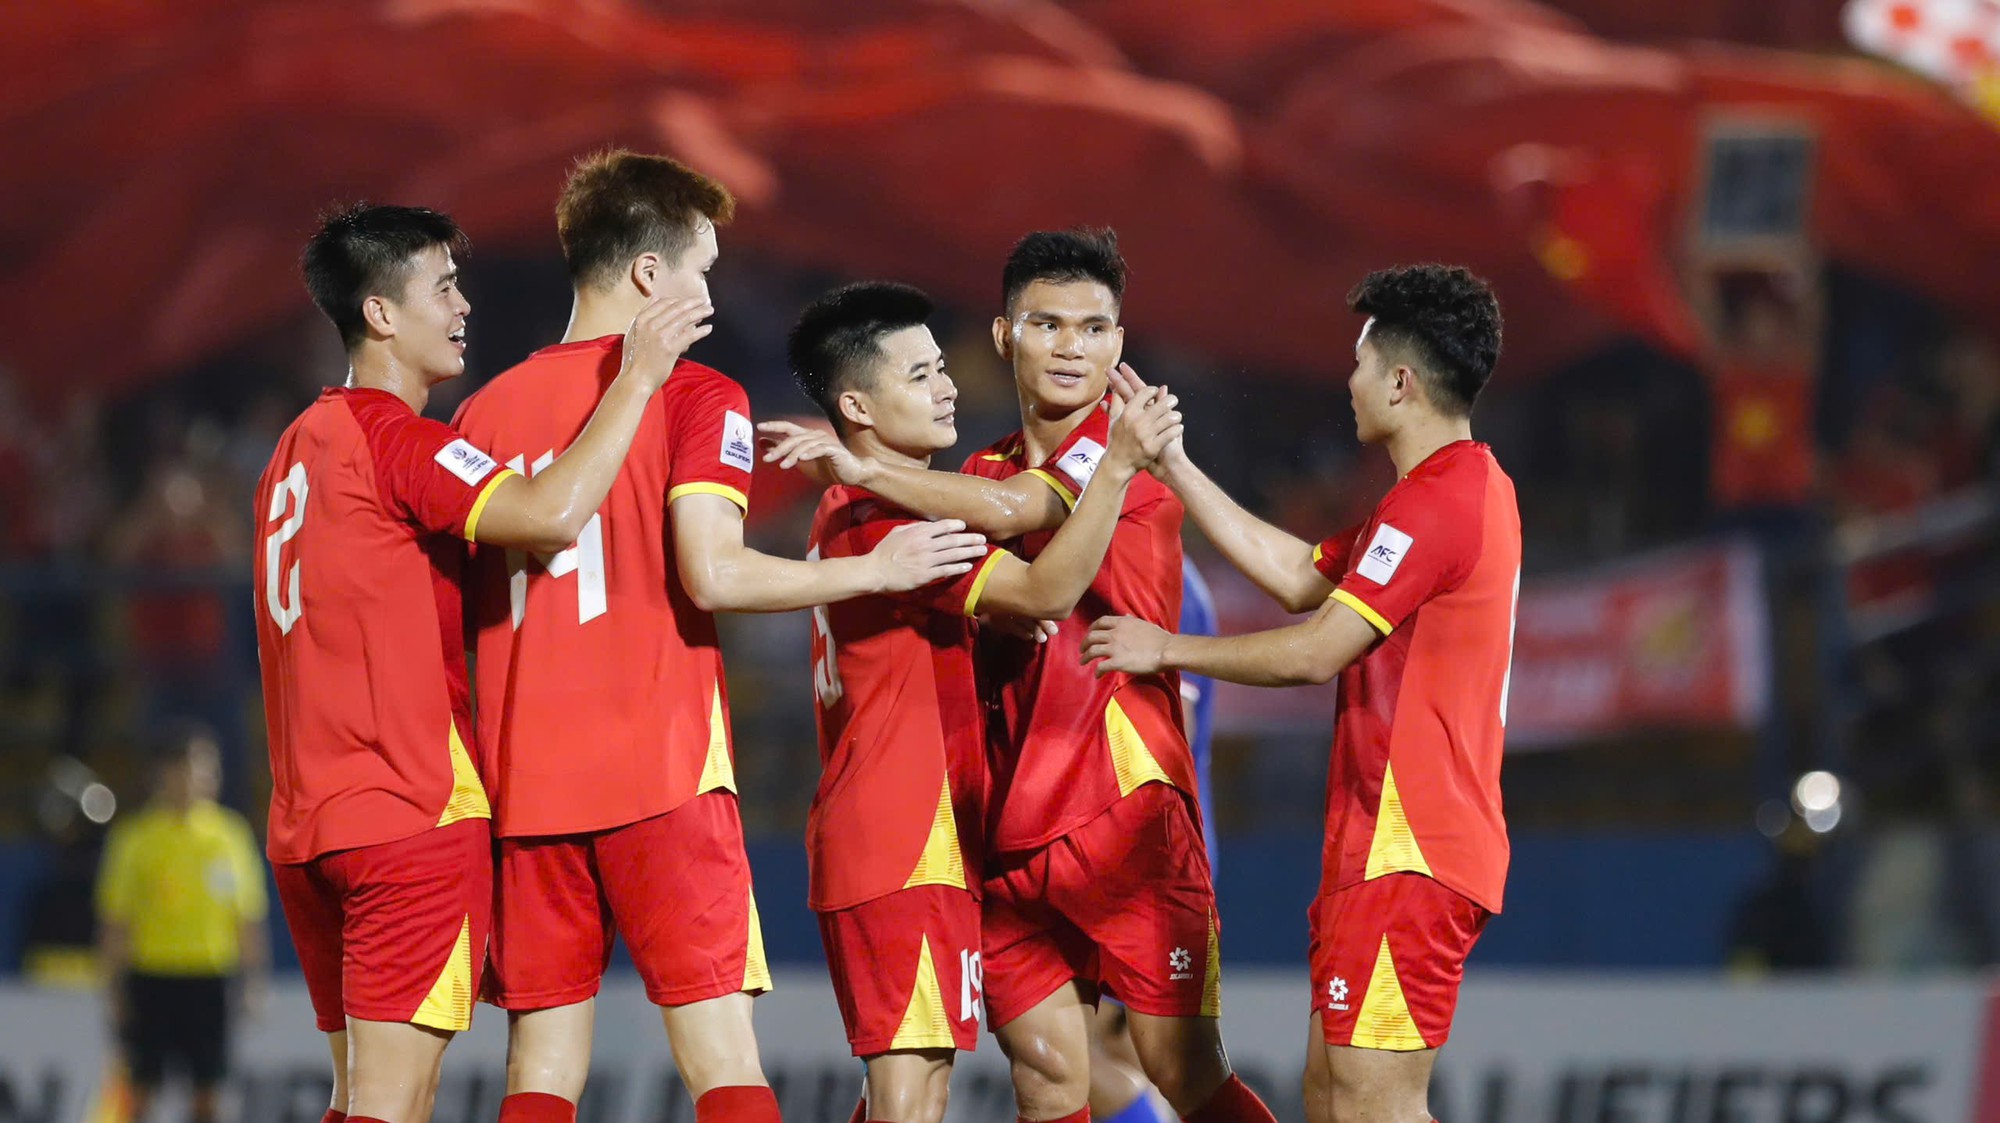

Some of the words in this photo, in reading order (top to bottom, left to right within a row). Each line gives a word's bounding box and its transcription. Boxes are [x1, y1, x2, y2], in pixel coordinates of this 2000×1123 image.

[266, 461, 309, 637] 2
[1370, 545, 1397, 563] AFC
[960, 948, 983, 1022] 19
